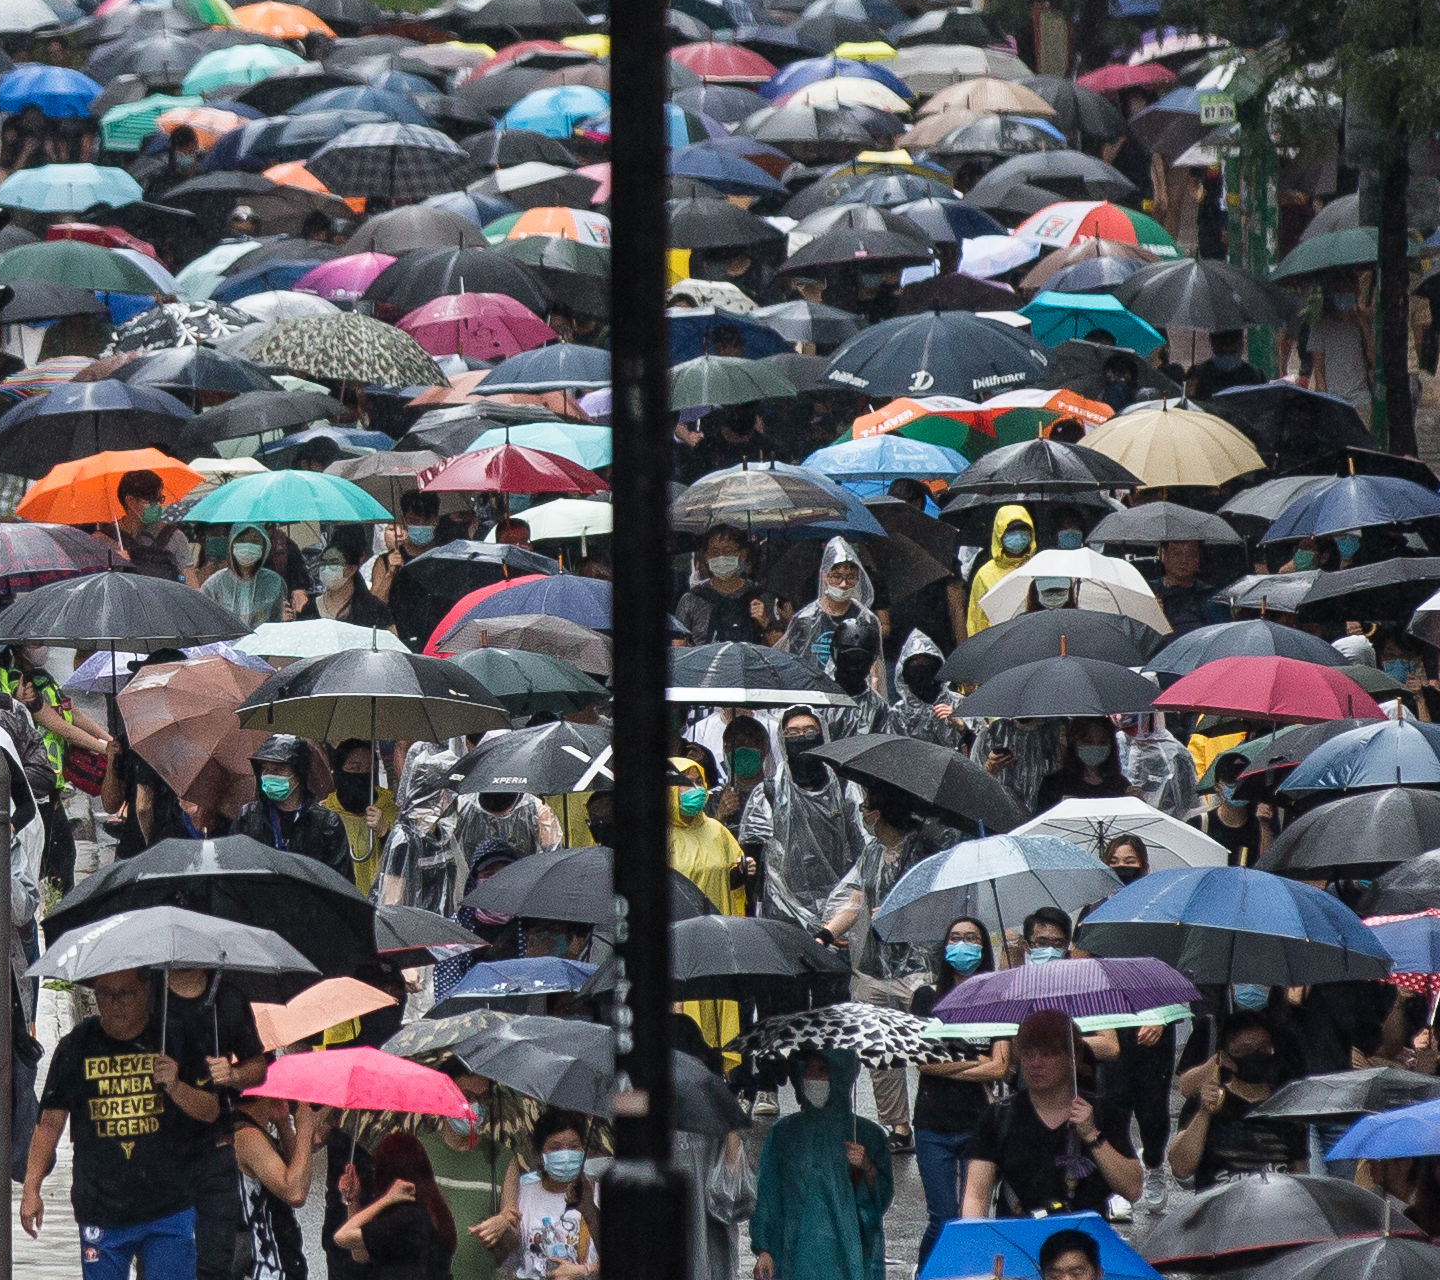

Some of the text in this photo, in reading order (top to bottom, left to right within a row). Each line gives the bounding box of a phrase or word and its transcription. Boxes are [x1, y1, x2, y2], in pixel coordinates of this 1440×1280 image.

[87, 1056, 154, 1077] FOREVE
[97, 1076, 153, 1095] MAMBA
[96, 1117, 160, 1137] LEGEND
